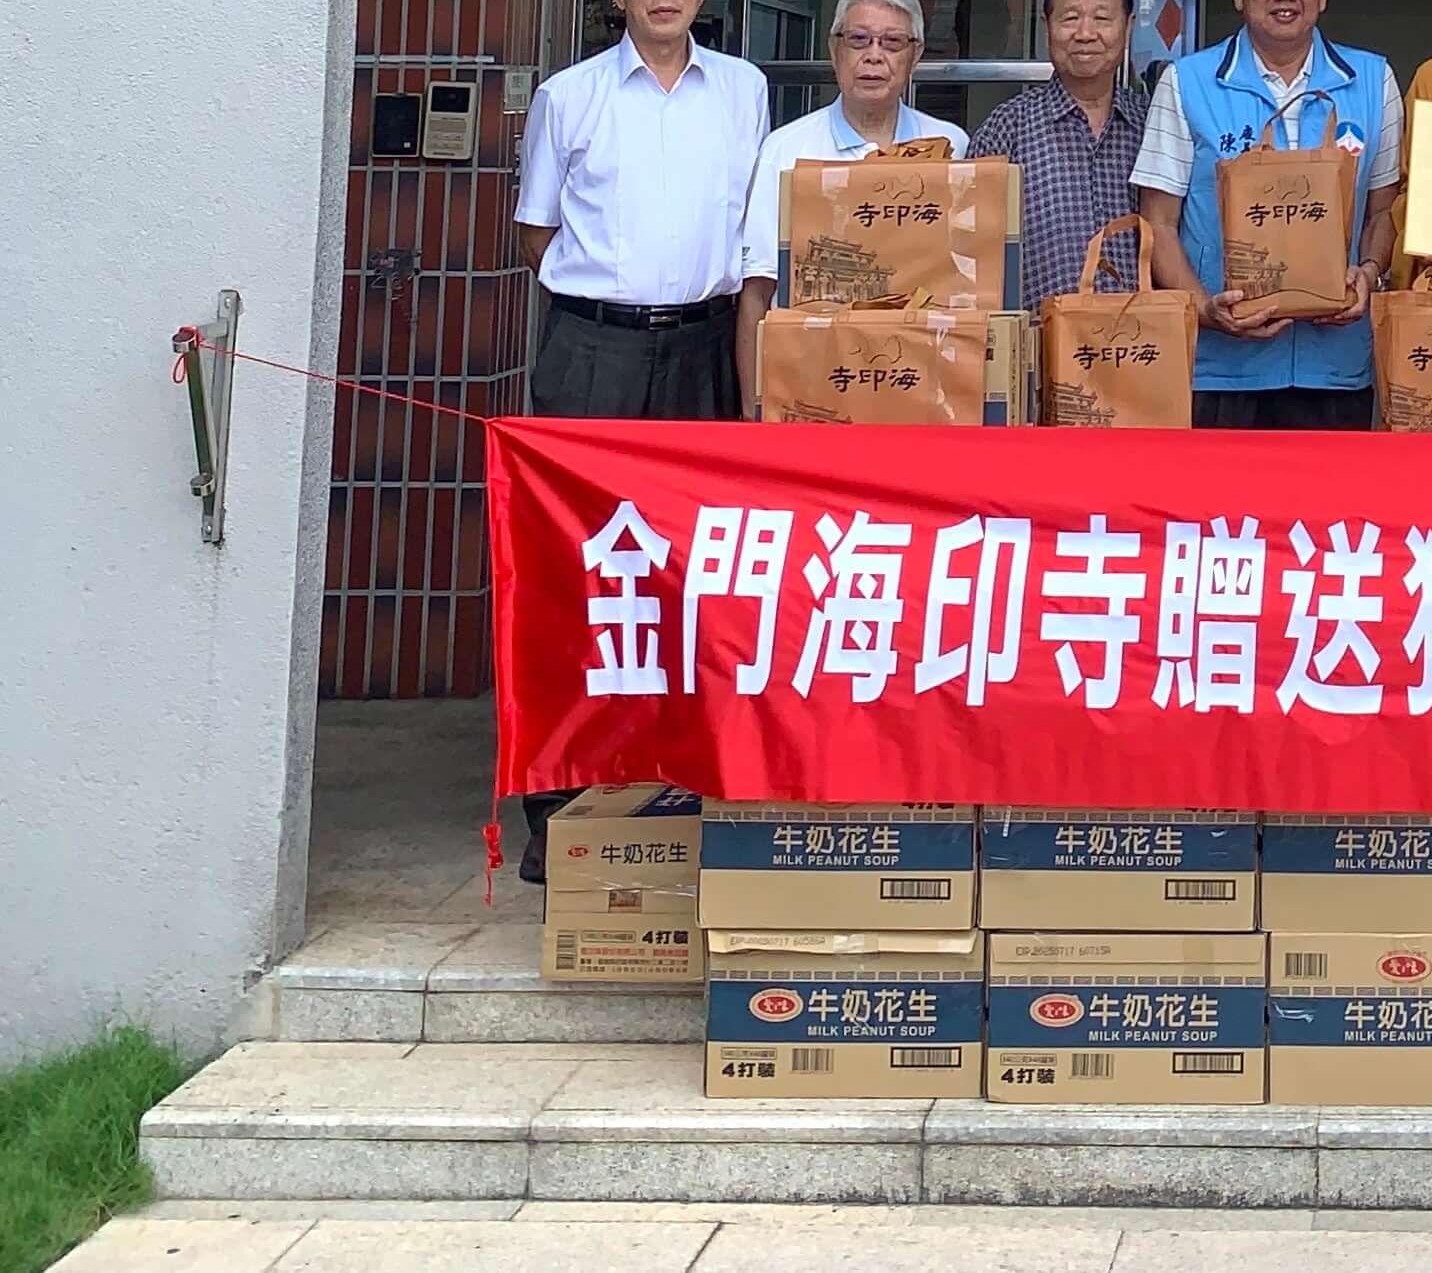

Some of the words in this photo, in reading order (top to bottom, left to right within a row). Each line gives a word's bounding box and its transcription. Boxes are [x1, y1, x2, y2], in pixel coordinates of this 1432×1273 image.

[773, 825, 901, 854] 牛奶花生
[1055, 826, 1184, 855] 牛奶花生
[600, 842, 689, 865] 牛奶花生
[773, 855, 803, 866] MILK
[807, 855, 859, 866] PEANUT
[864, 855, 899, 866] SOUP
[1055, 855, 1086, 866] MILK
[1090, 855, 1142, 866] PEANUT
[1146, 855, 1183, 866] SOUP
[1335, 858, 1366, 869] MILK
[1370, 858, 1422, 869] PEANUT
[808, 988, 938, 1023] 牛奶花生
[1089, 993, 1219, 1028] 牛奶花生
[808, 1025, 838, 1037] MILK
[843, 1025, 895, 1037] PEANUT
[900, 1025, 936, 1037] SOUP
[1089, 1030, 1120, 1042] MILK
[1125, 1030, 1177, 1042] PEANUT
[1182, 1030, 1218, 1042] SOUP
[1344, 1031, 1376, 1042] MILK
[1381, 1031, 1432, 1042] PEANUT
